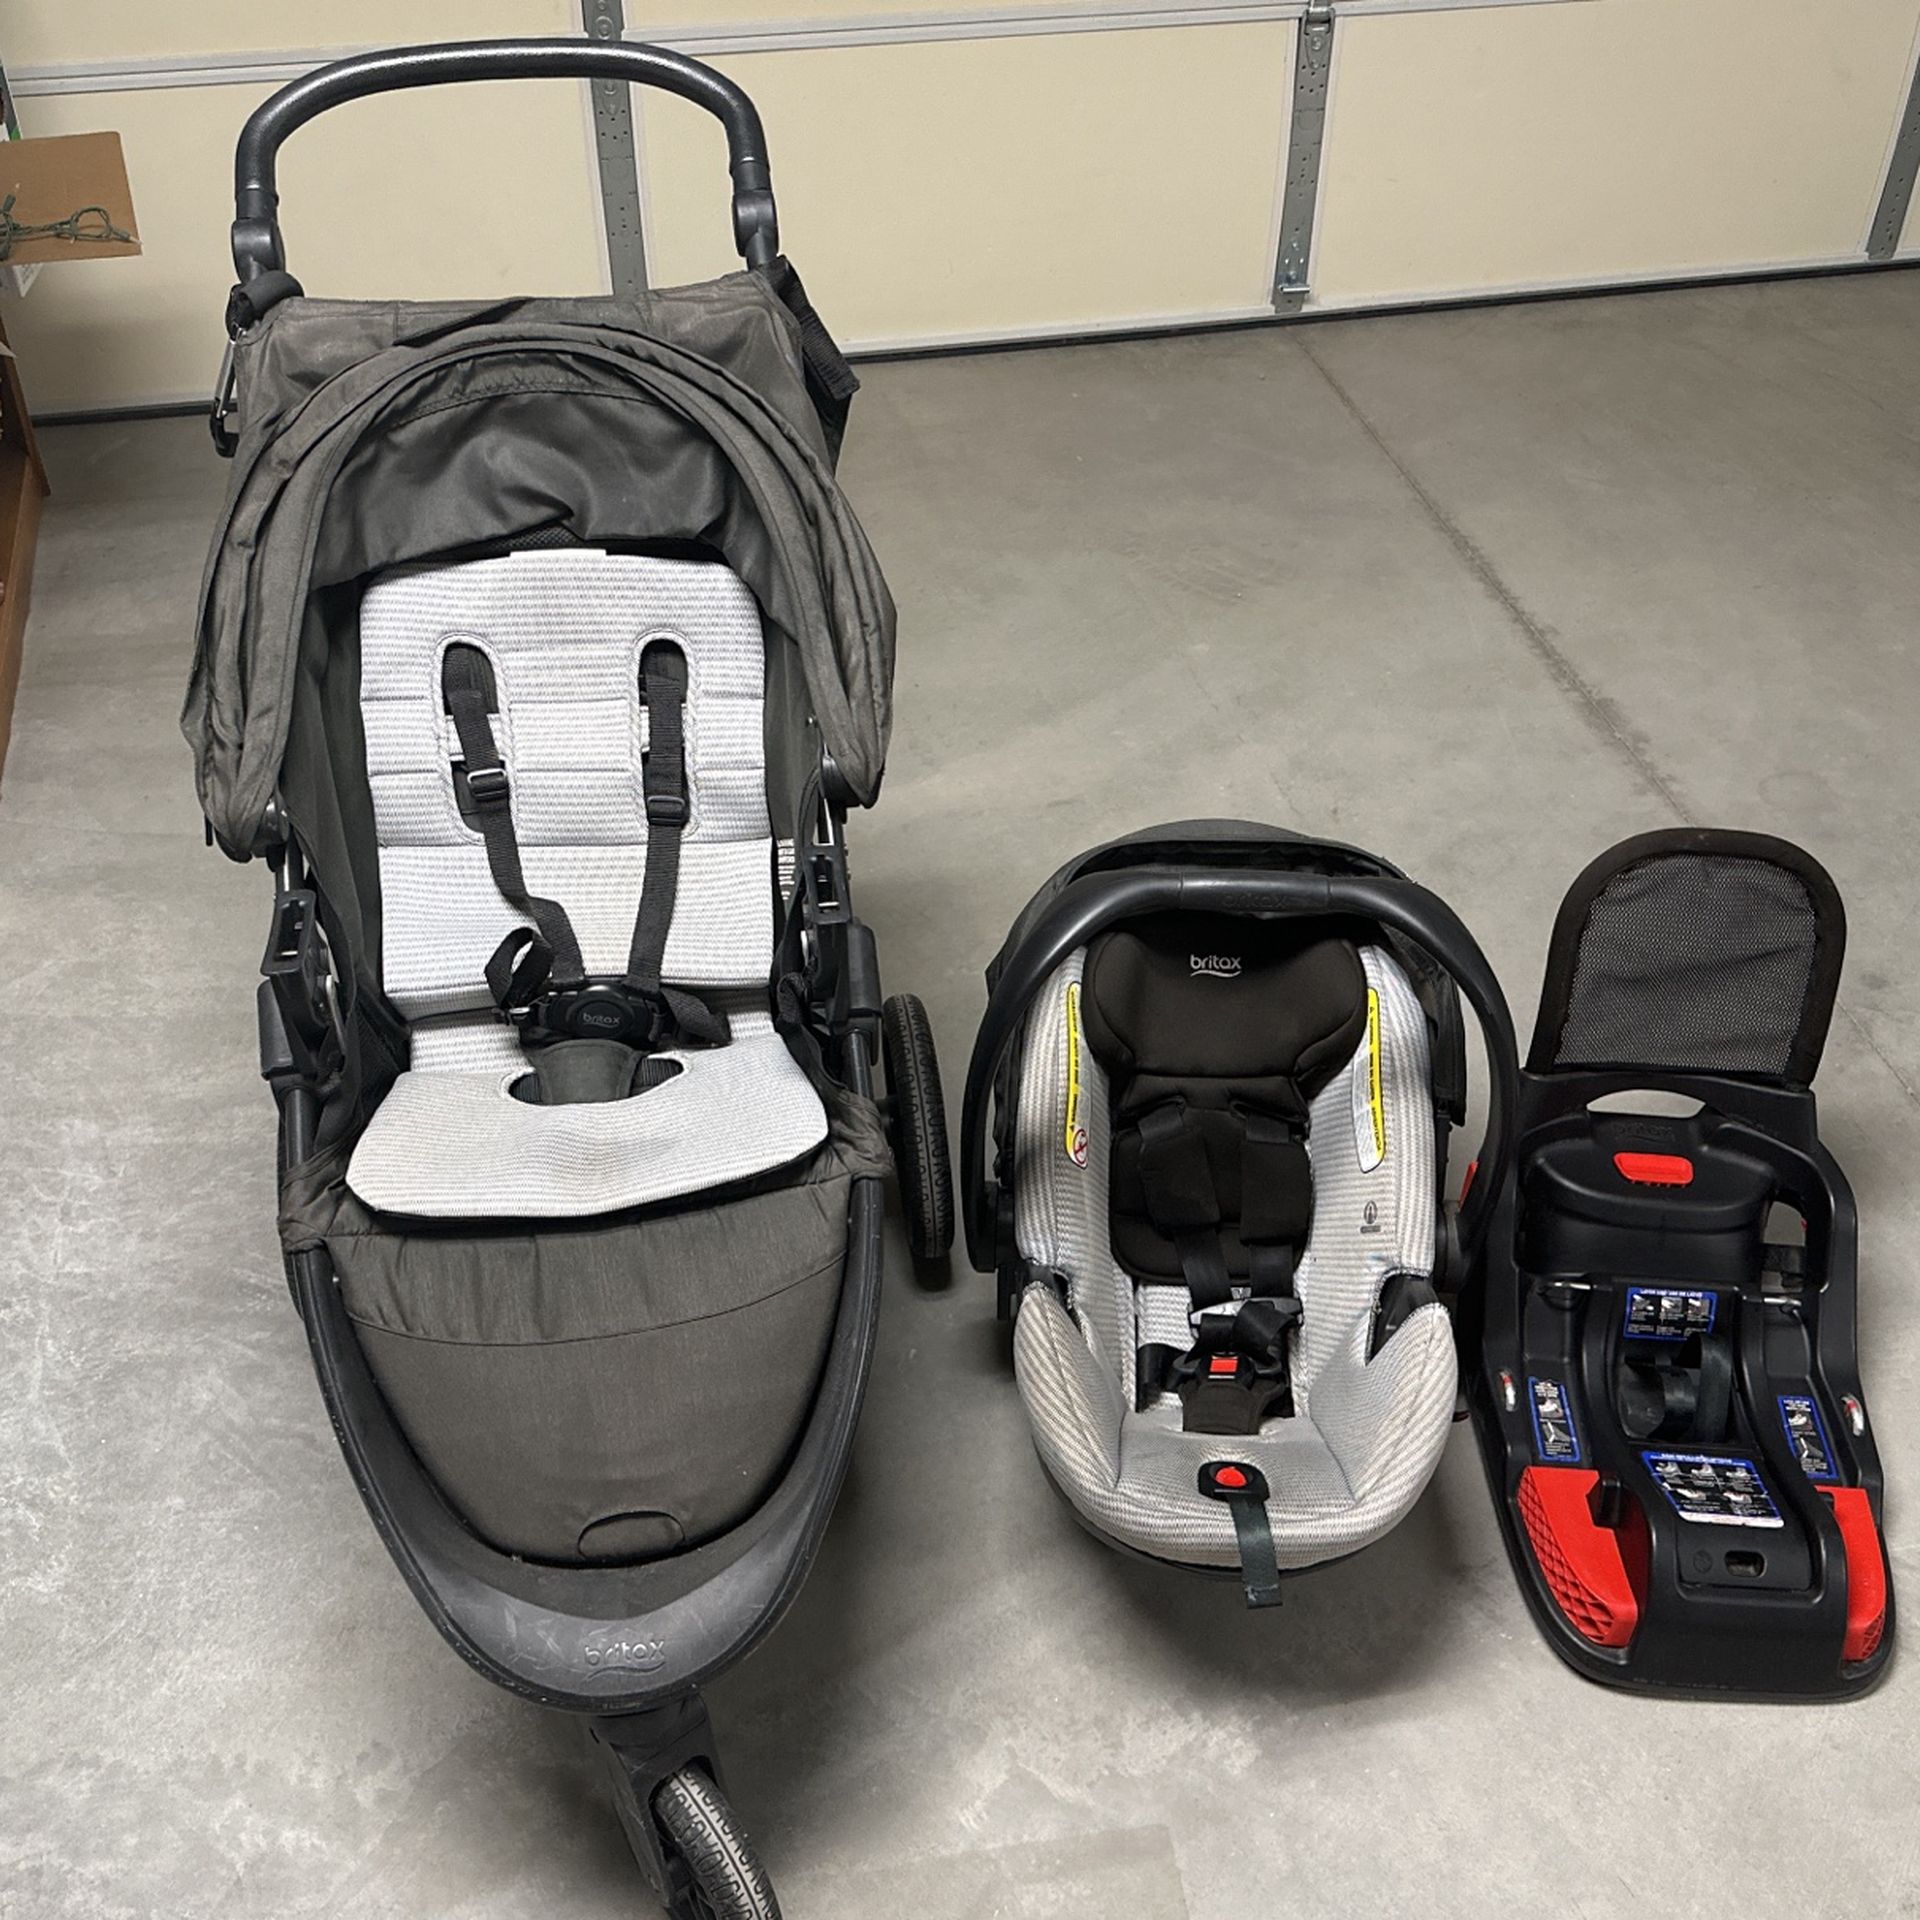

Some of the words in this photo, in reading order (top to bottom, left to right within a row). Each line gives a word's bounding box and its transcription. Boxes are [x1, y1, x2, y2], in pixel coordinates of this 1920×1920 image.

[1190, 954, 1242, 970] britax
[582, 1012, 621, 1024] britax
[584, 1641, 665, 1667] britax
